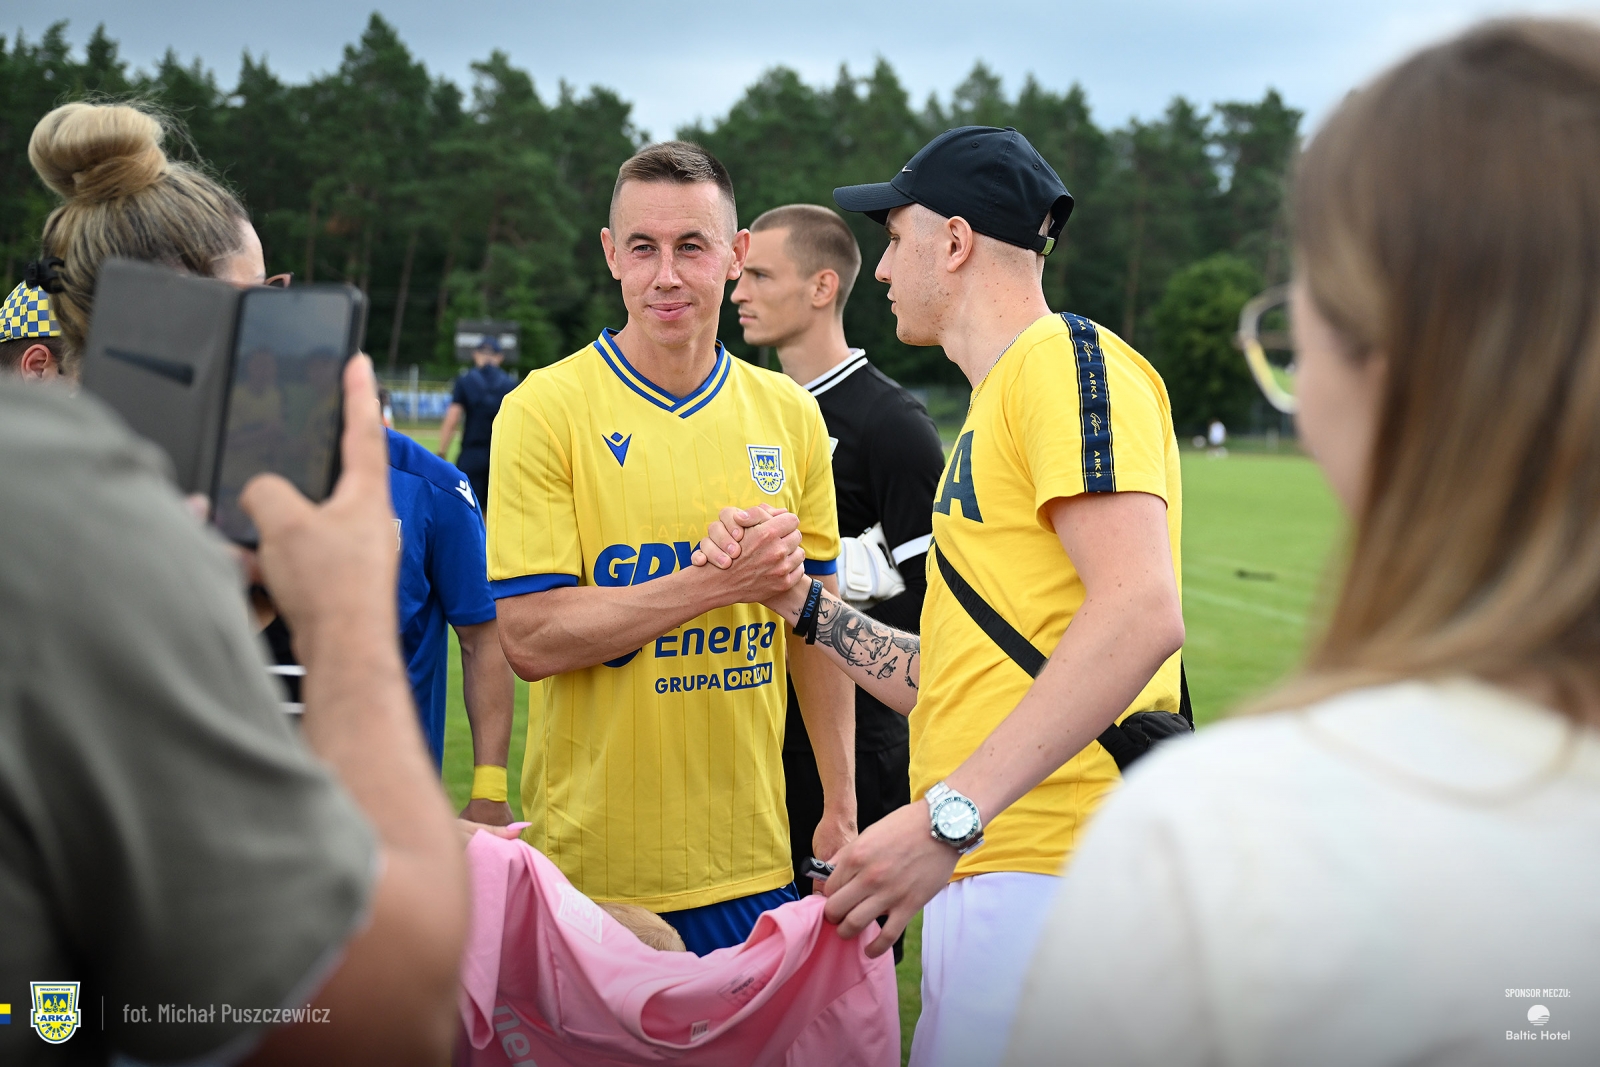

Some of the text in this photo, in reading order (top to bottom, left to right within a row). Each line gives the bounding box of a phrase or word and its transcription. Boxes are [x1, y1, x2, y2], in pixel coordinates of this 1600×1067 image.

[1089, 371, 1098, 400] ARKA
[1093, 450, 1103, 479] ARKA
[803, 582, 821, 618] GDYNIA
[655, 622, 777, 661] Energa
[655, 664, 771, 694] GRUPA ORLN
